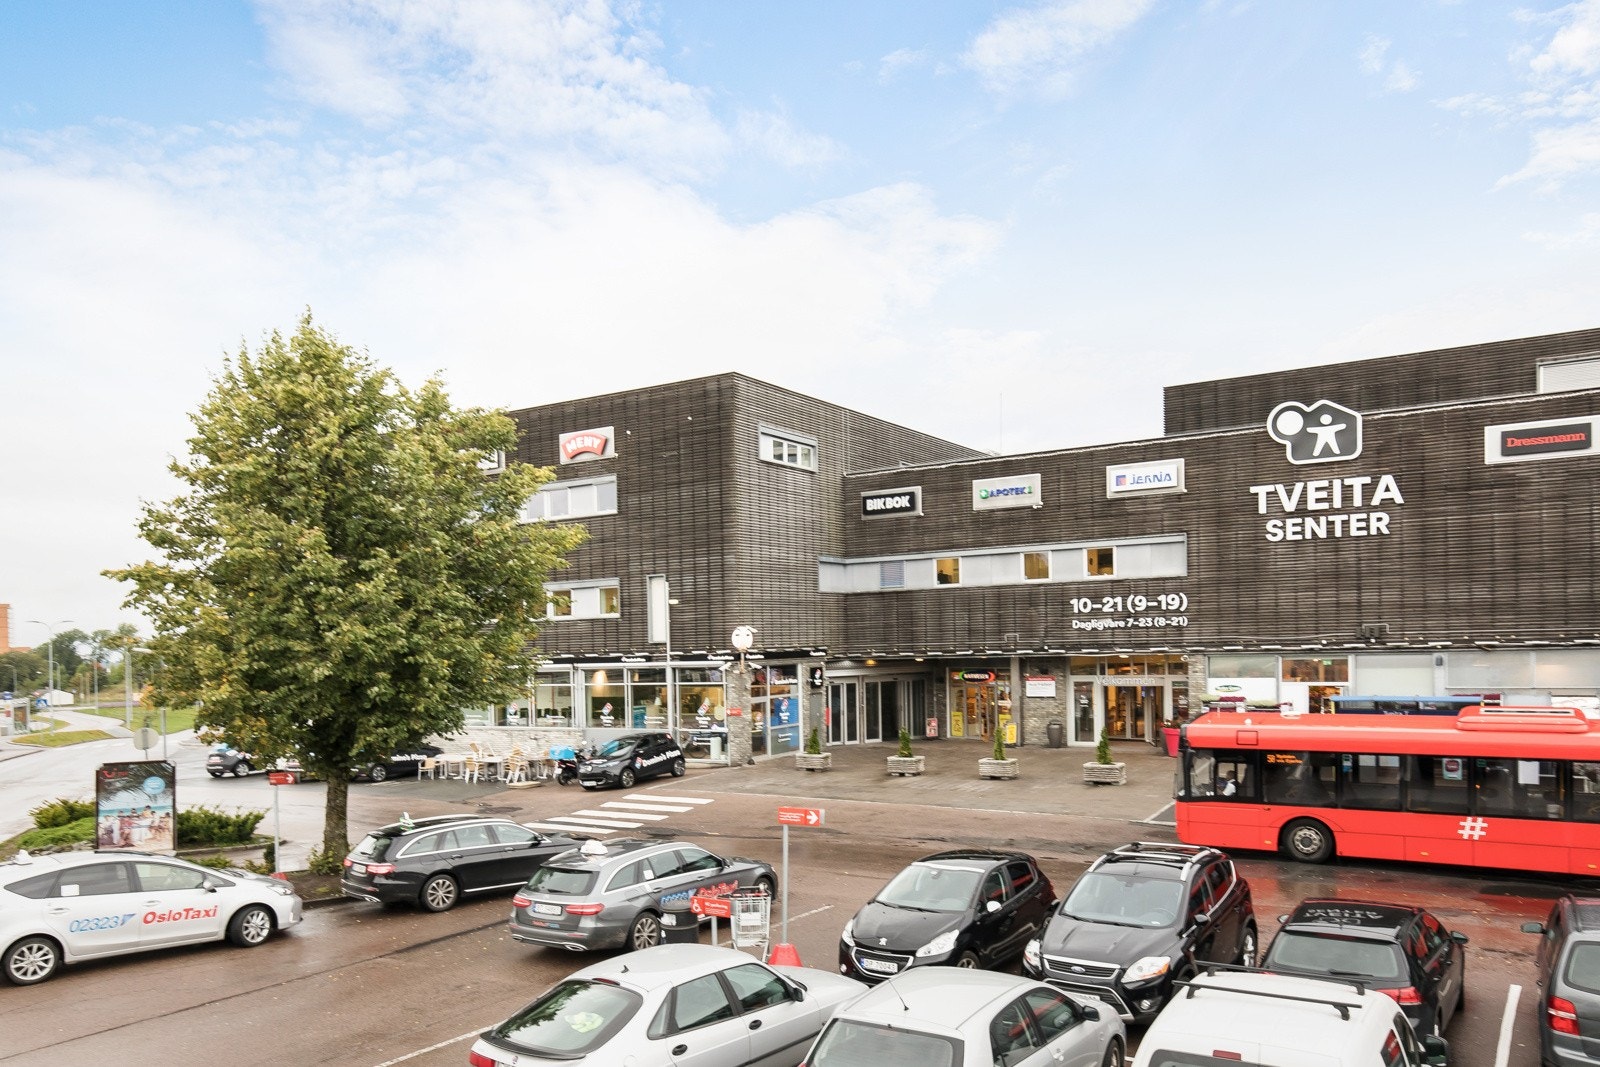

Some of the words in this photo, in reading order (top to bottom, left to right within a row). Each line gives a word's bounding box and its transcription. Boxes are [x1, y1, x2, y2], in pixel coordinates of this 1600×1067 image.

[565, 435, 602, 453] MENY
[1505, 432, 1586, 448] Dressmann
[989, 487, 1026, 499] APOTEK
[1249, 474, 1405, 514] TVEITA
[1265, 512, 1391, 542] SENTER
[1069, 596, 1123, 613] 10-21
[1126, 592, 1188, 613] (9-19)
[1071, 618, 1125, 631] Dagligvare
[1126, 617, 1153, 627] 7-23
[1153, 616, 1188, 627] (8-21)
[1096, 675, 1156, 685] Velkommen
[69, 915, 119, 933] 02323
[143, 905, 218, 925] OsloTaxi
